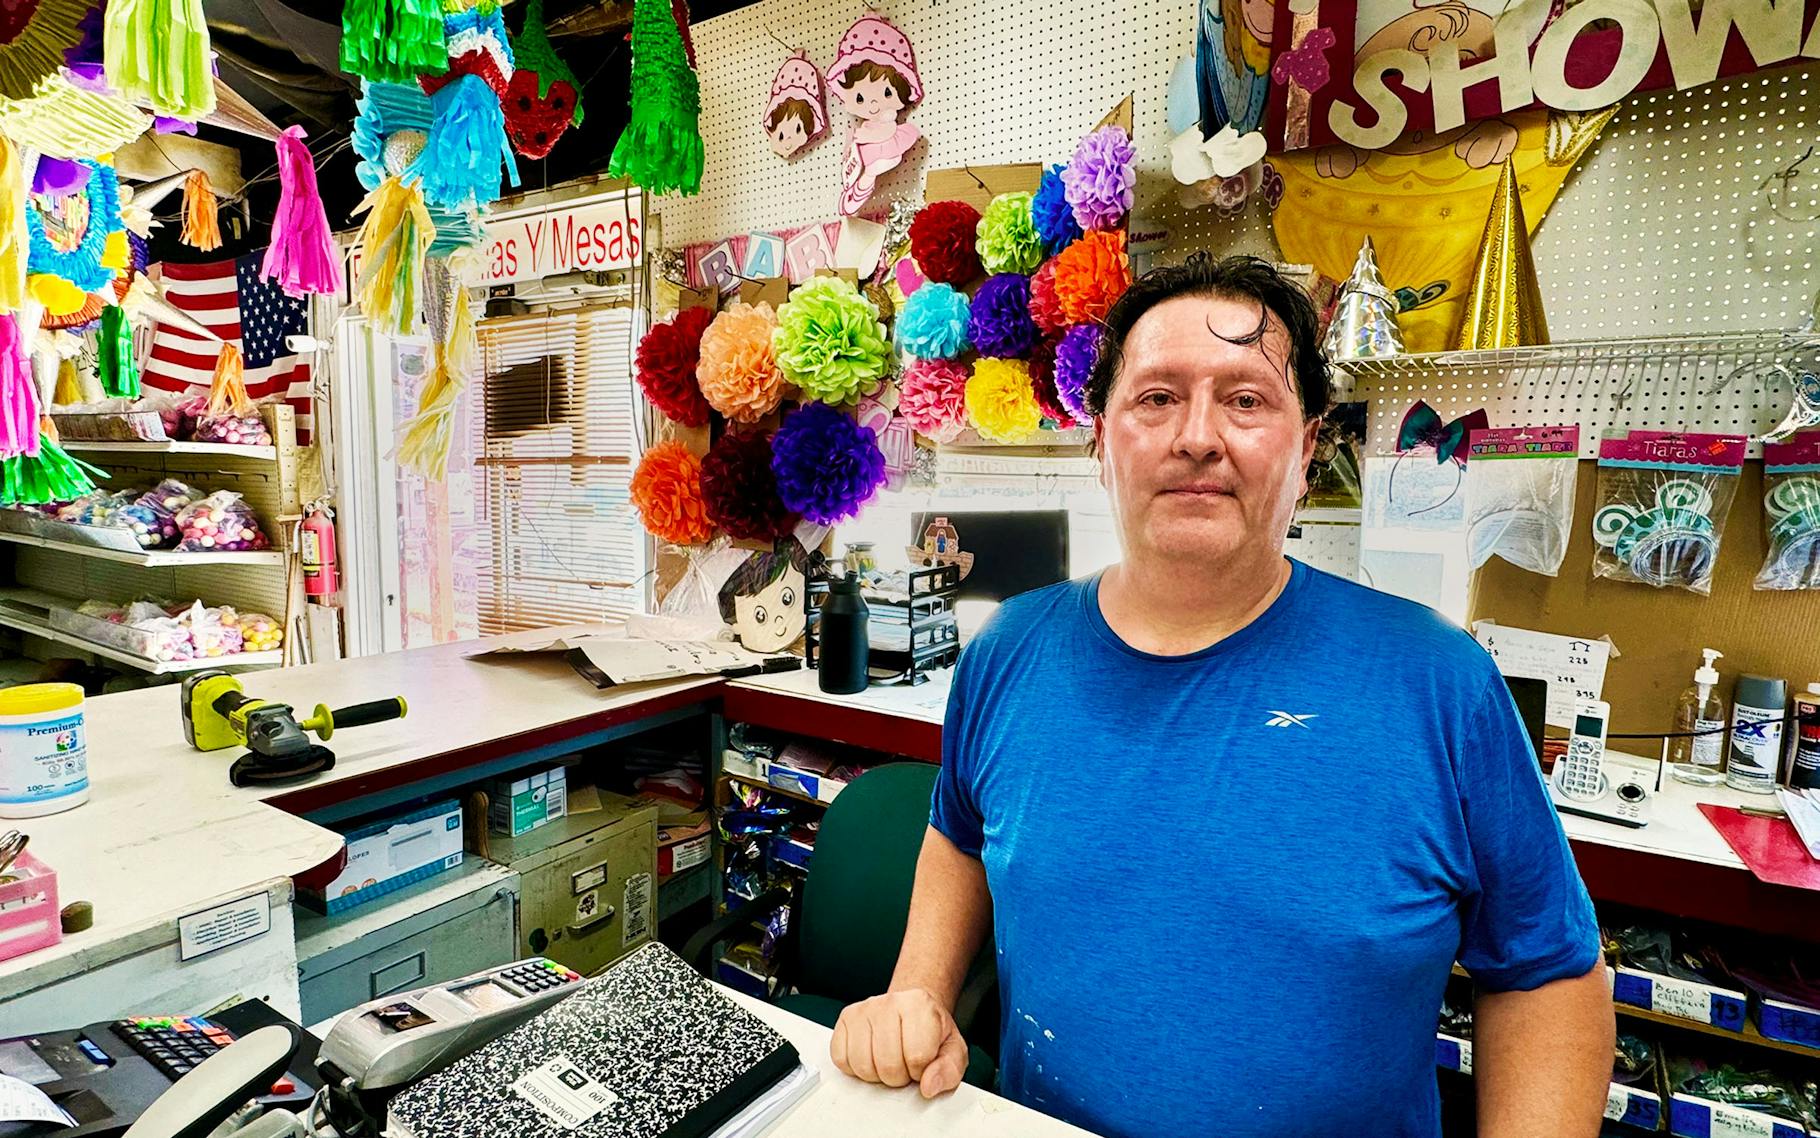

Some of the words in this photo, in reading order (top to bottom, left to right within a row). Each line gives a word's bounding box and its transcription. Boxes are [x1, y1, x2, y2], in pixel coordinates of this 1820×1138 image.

[1328, 0, 1820, 150] SHOW
[524, 220, 543, 273] Y
[552, 214, 640, 270] Mesas
[1472, 443, 1518, 453] TIARA
[1643, 440, 1698, 459] Tiaras
[1735, 719, 1767, 739] 2X
[27, 784, 43, 792] 100
[1655, 982, 1678, 995] Ben
[1682, 990, 1694, 998] 10
[520, 1080, 579, 1125] COMPOSITION
[588, 1091, 607, 1104] 100
